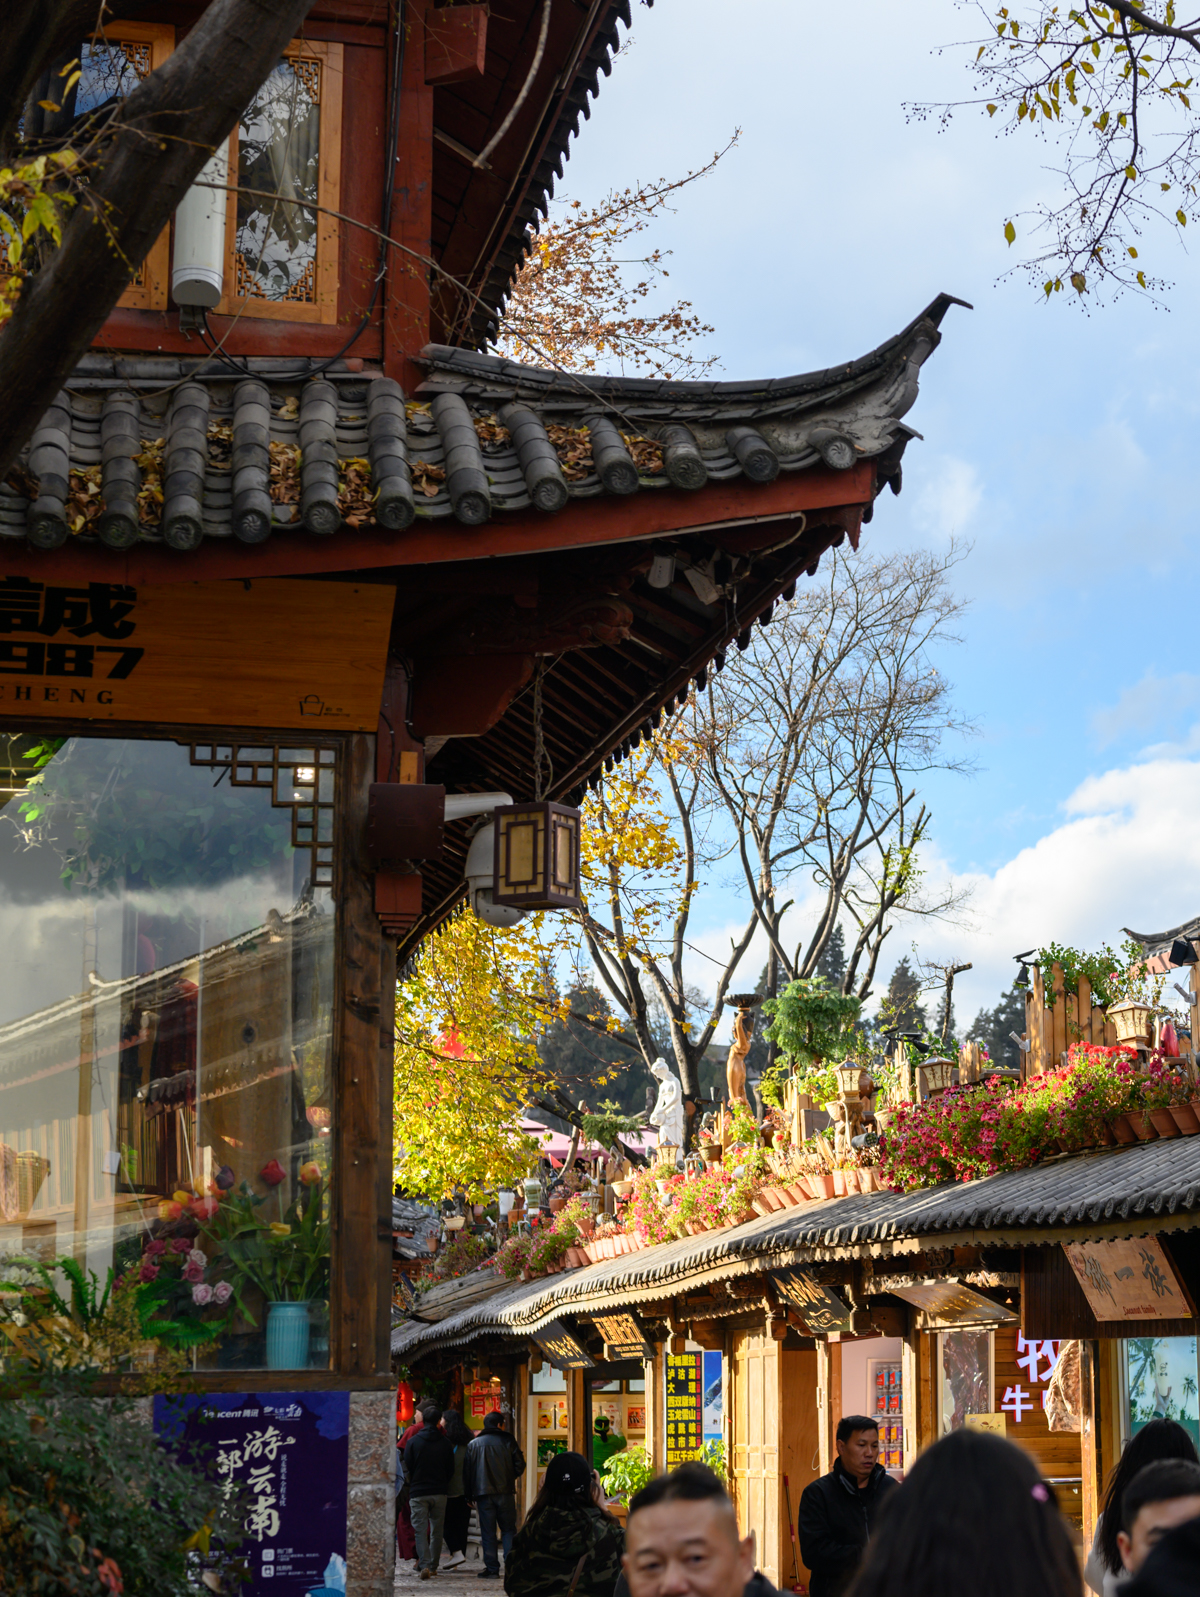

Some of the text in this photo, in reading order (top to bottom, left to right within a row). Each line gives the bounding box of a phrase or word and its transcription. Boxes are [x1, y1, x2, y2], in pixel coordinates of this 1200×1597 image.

[216, 1438, 244, 1521] 一部手
[243, 1425, 297, 1543] 游云南
